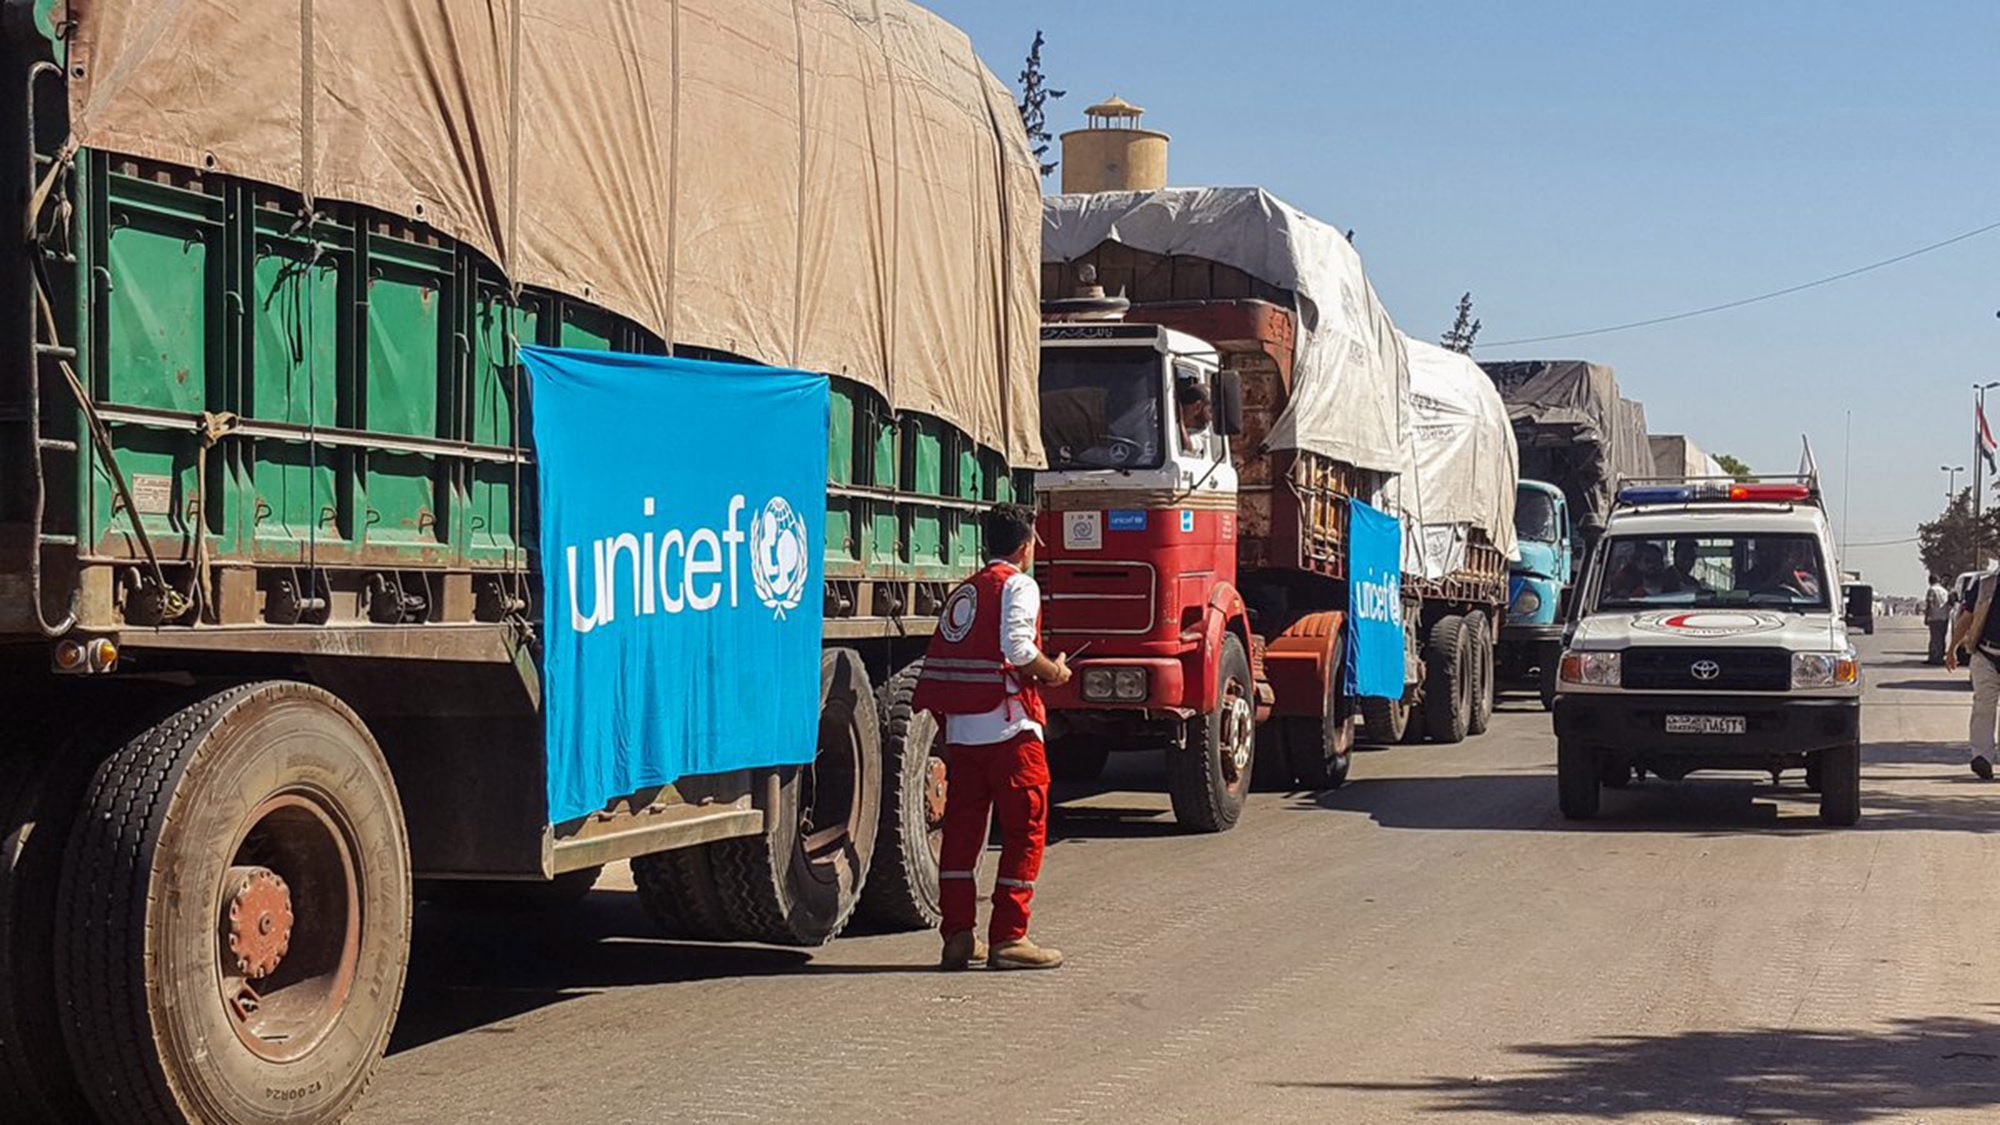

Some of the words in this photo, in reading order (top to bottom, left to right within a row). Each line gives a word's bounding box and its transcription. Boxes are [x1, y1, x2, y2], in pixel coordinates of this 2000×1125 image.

[1111, 515, 1135, 525] unicef
[566, 494, 746, 633] unicef
[1356, 567, 1389, 622] unicef
